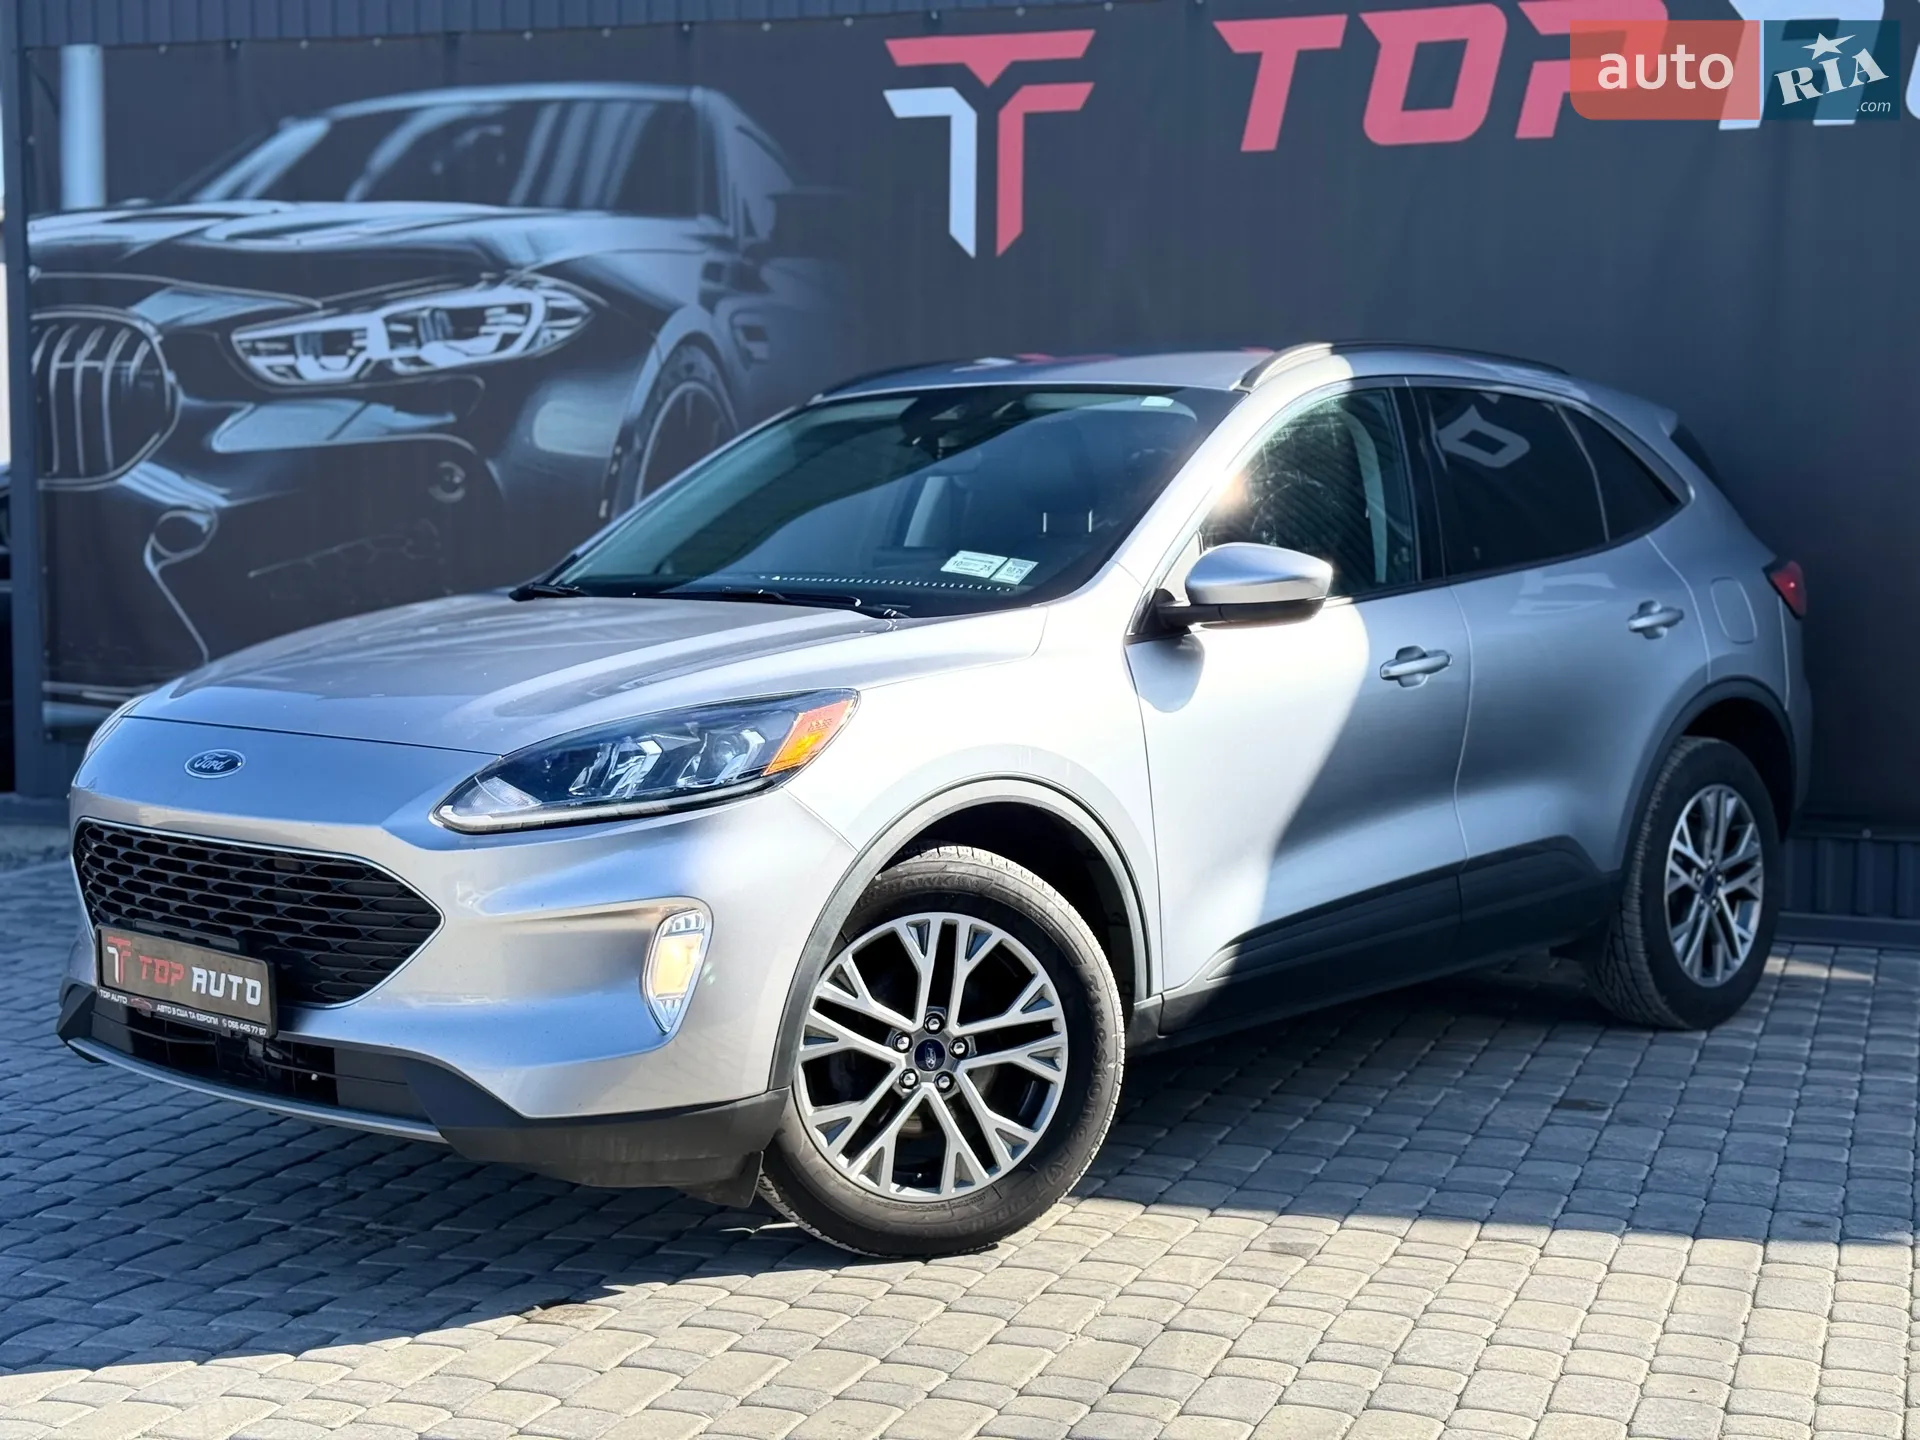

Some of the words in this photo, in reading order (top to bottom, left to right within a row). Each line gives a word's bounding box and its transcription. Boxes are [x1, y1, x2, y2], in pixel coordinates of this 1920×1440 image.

[1213, 0, 1668, 152] TOP
[1719, 0, 1920, 129] A
[194, 752, 232, 771] Ford
[139, 955, 185, 986] TOP
[191, 967, 261, 1006] AUTO
